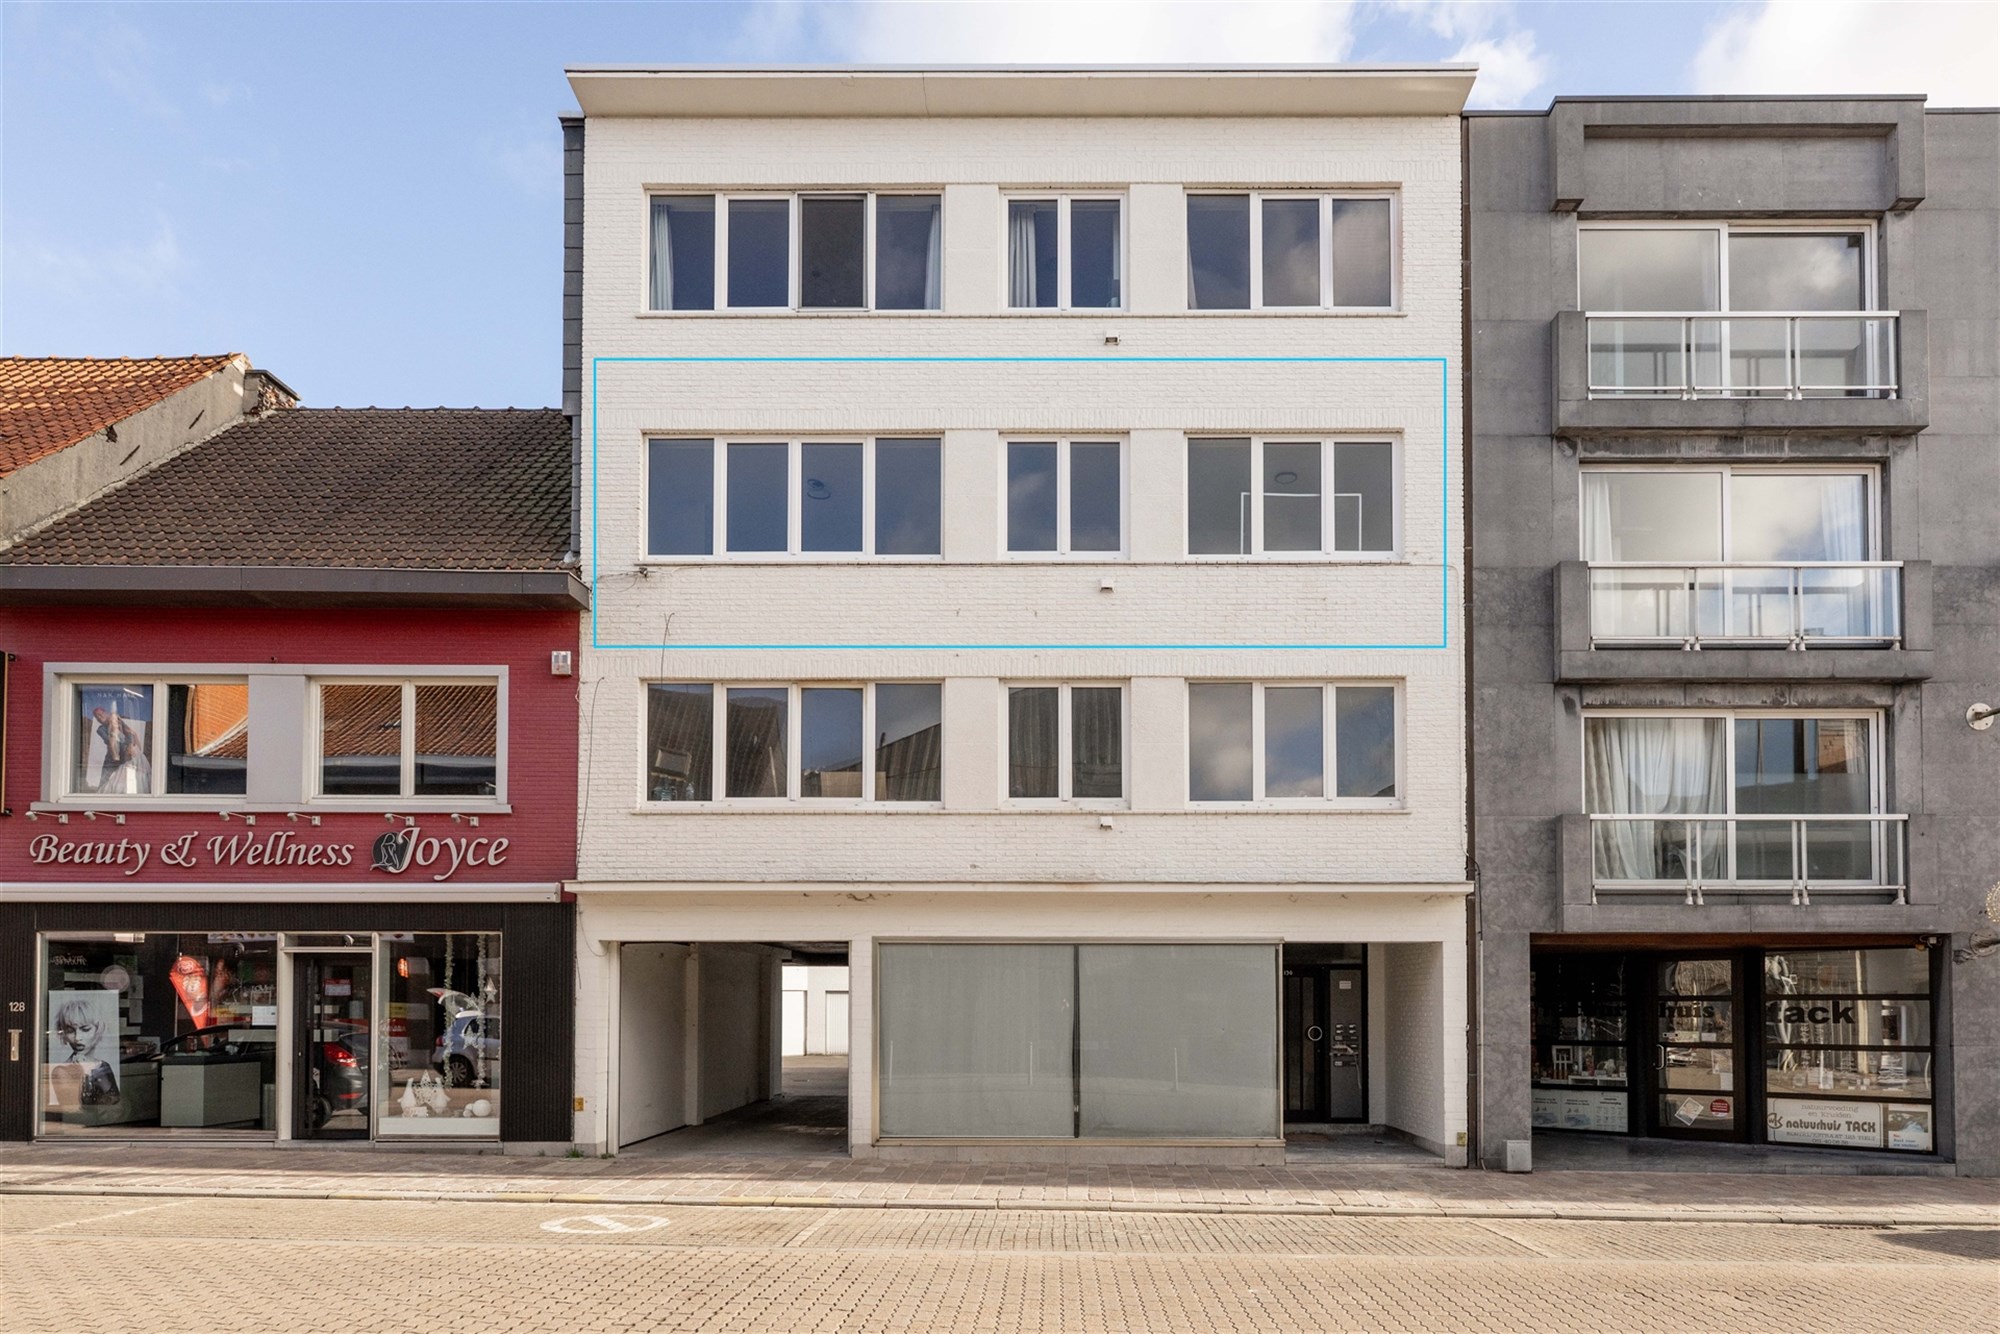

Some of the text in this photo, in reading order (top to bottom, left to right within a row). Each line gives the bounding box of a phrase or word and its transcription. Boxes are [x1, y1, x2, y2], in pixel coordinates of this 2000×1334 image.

[29, 827, 510, 880] Beauty & Wellness Joyce
[9, 1001, 26, 1012] 128
[1801, 1103, 1859, 1113] natuurvoeding
[1820, 1111, 1852, 1119] kruiden
[1786, 1119, 1876, 1133] natuurhuis TACK
